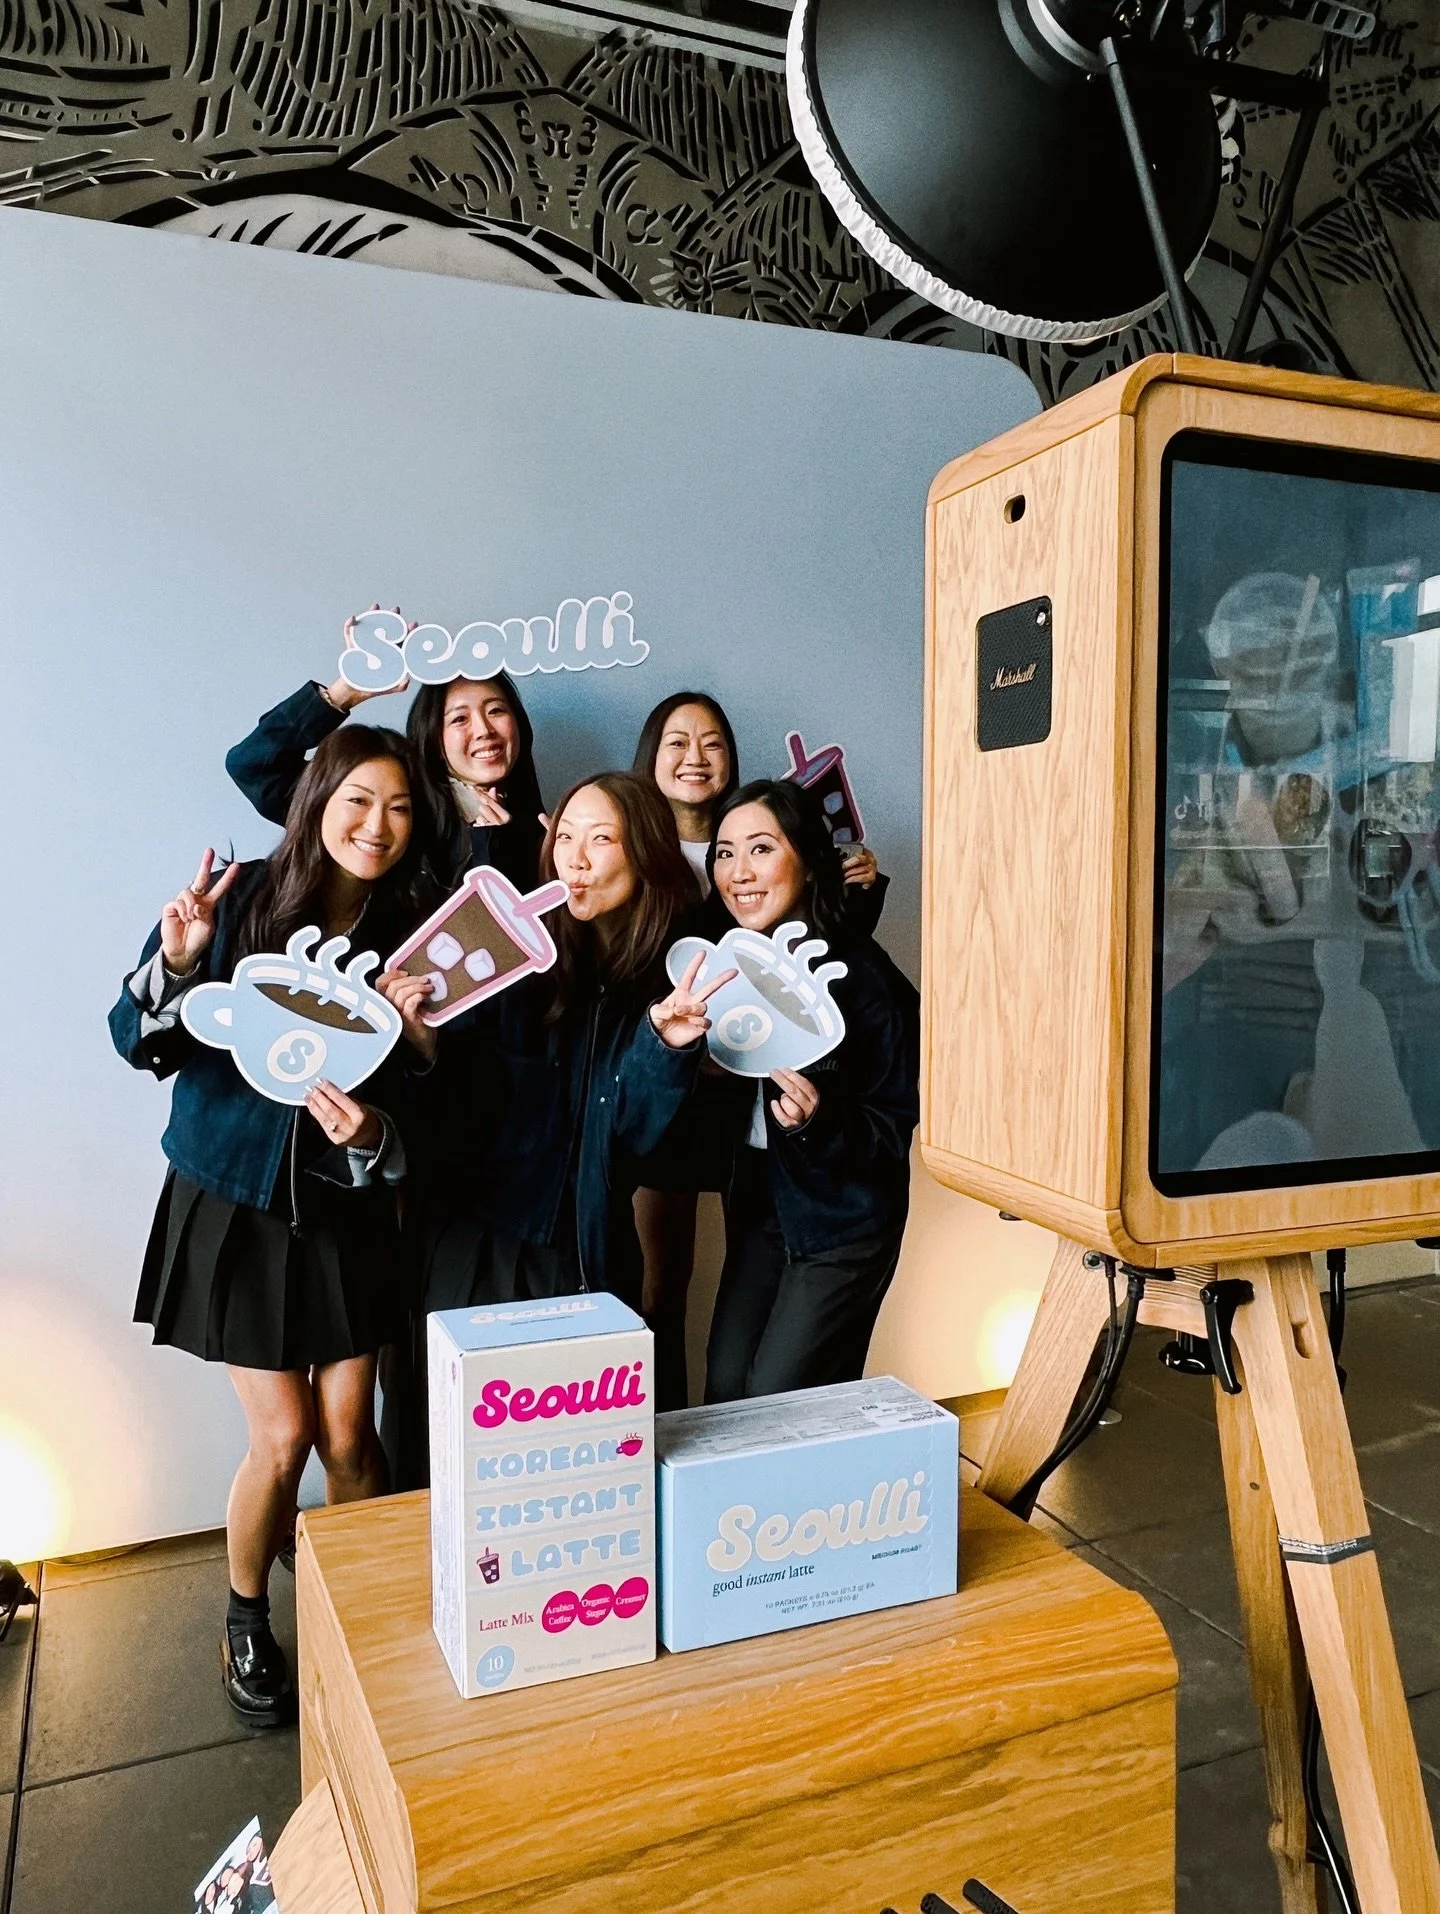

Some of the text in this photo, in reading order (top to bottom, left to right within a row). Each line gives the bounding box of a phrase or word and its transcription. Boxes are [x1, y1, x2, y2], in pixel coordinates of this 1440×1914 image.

[338, 591, 650, 692] Seoulli
[990, 663, 1037, 690] Marshall
[277, 1037, 316, 1076] S
[473, 1360, 646, 1429] Seoulli
[475, 1438, 619, 1482] KOREAN
[475, 1483, 643, 1531] INSTANT
[706, 1470, 929, 1573] Seoulli
[511, 1529, 641, 1576] LATTE
[712, 1564, 815, 1597] good instant latte
[546, 1602, 575, 1615] Arabica
[581, 1596, 610, 1608] Organic
[585, 1608, 607, 1619] Sugar
[479, 1612, 534, 1632] Latte Mix
[486, 1656, 504, 1672] 10
